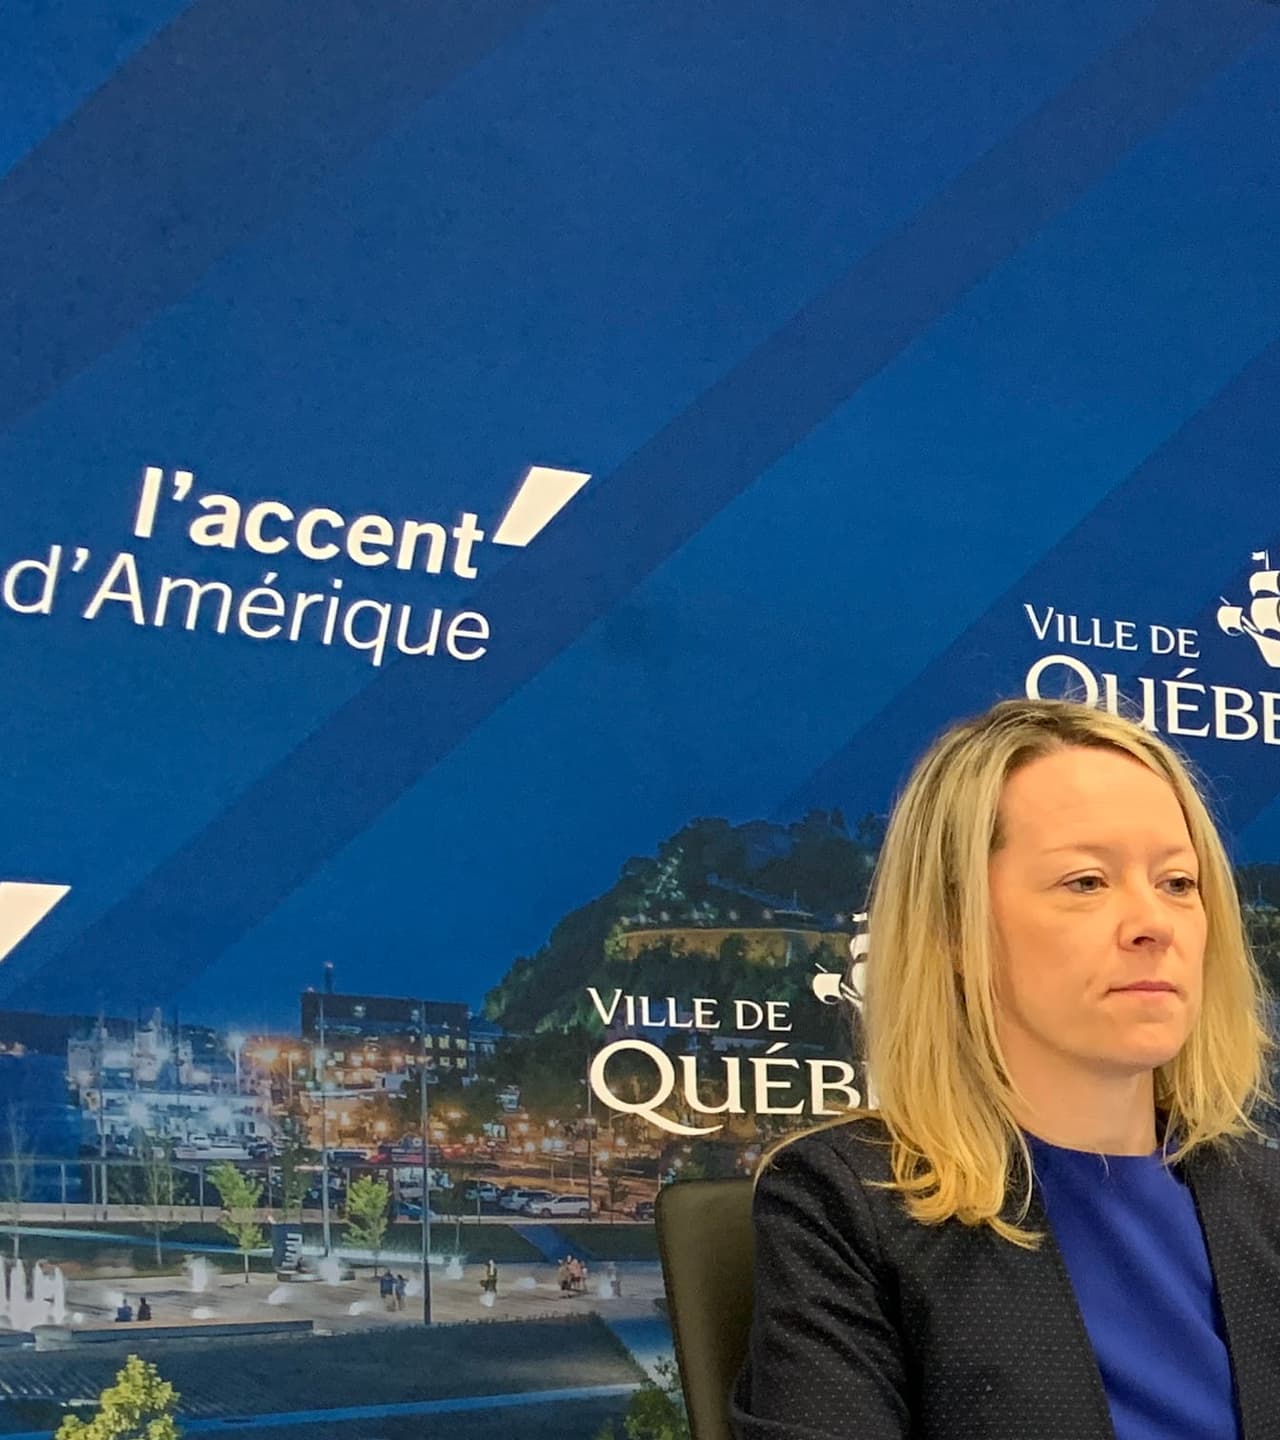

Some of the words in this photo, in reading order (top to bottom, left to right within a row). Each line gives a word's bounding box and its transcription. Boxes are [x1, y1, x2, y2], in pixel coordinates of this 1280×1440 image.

[134, 466, 486, 579] l'accent
[2, 545, 491, 667] d'Amérique
[1024, 603, 1138, 651] VILLE
[1150, 624, 1200, 658] DE
[587, 987, 721, 1029] VILLE
[734, 1000, 792, 1031] DE
[589, 1039, 879, 1136] QUÉB
